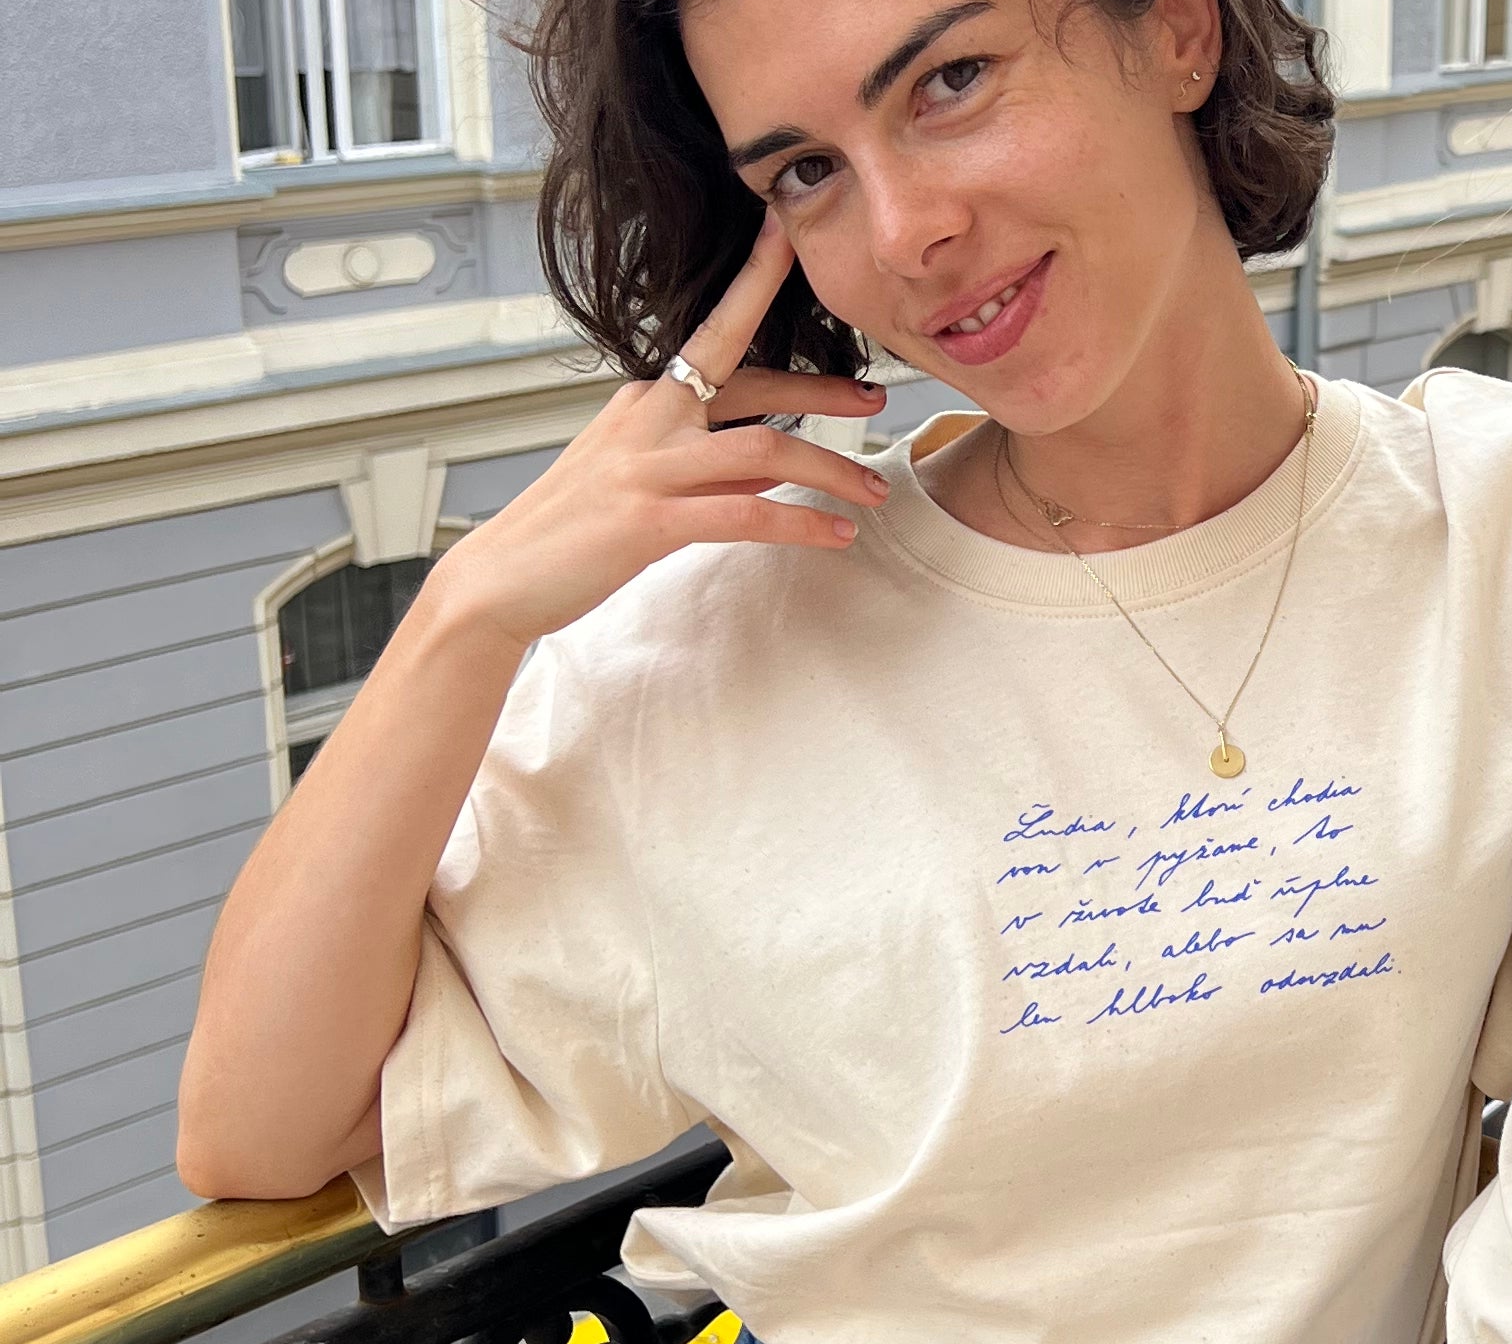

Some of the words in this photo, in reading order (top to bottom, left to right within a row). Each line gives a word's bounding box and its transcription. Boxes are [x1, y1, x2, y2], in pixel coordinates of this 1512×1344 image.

[1160, 788, 1251, 830] ktorí
[1266, 777, 1361, 812] chodia
[996, 863, 1060, 885] von
[1083, 857, 1118, 875] v
[1293, 815, 1353, 845] to
[1001, 912, 1042, 935] v
[1058, 894, 1160, 928] živote
[1270, 865, 1377, 918] úplne
[1003, 943, 1132, 981] vzdali,
[1160, 927, 1255, 960] alebo
[1270, 927, 1320, 946] sa
[1329, 917, 1386, 941] mu
[1000, 1001, 1062, 1035] len
[1088, 972, 1221, 1024] hlboko
